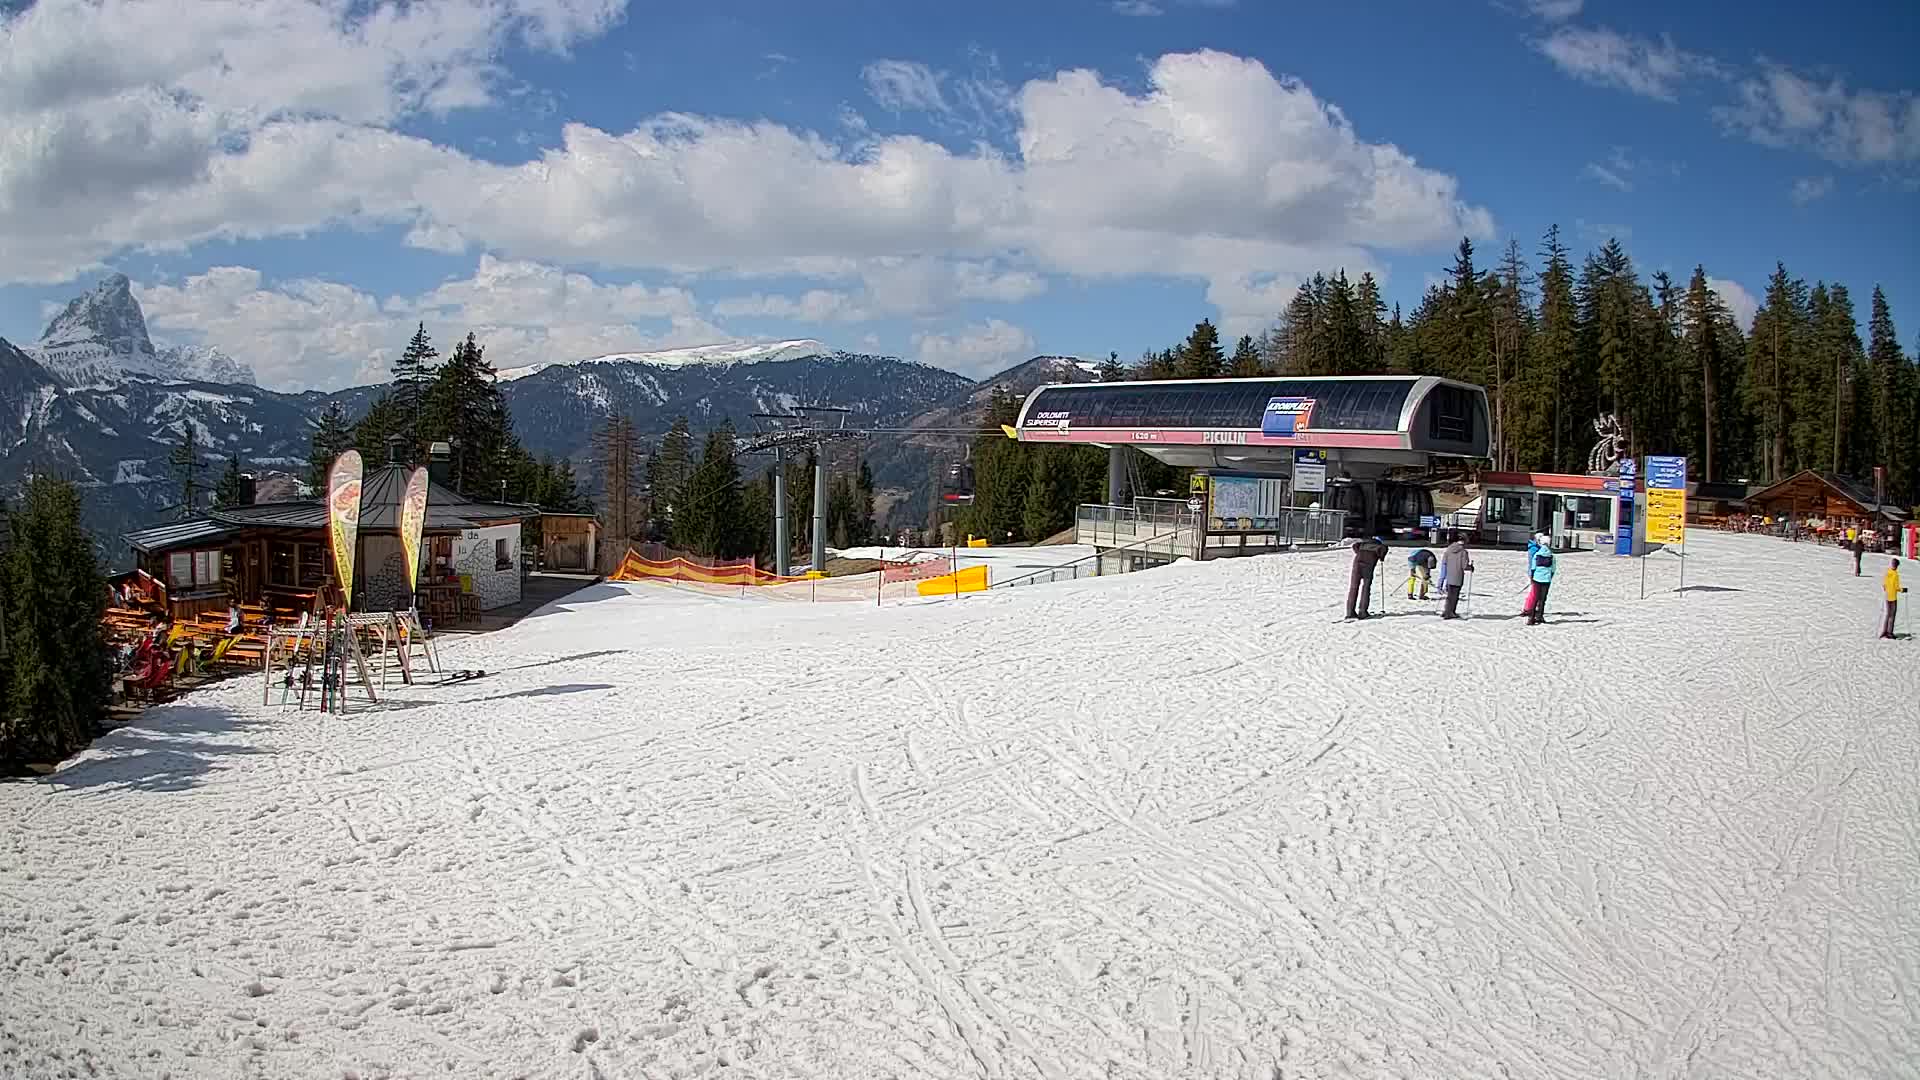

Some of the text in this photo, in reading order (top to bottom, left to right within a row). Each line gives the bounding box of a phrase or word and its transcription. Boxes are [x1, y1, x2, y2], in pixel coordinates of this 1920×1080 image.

[1036, 411, 1070, 419] DOLOMITI
[1130, 432, 1149, 440] 1620
[1202, 431, 1247, 444] PICULIN
